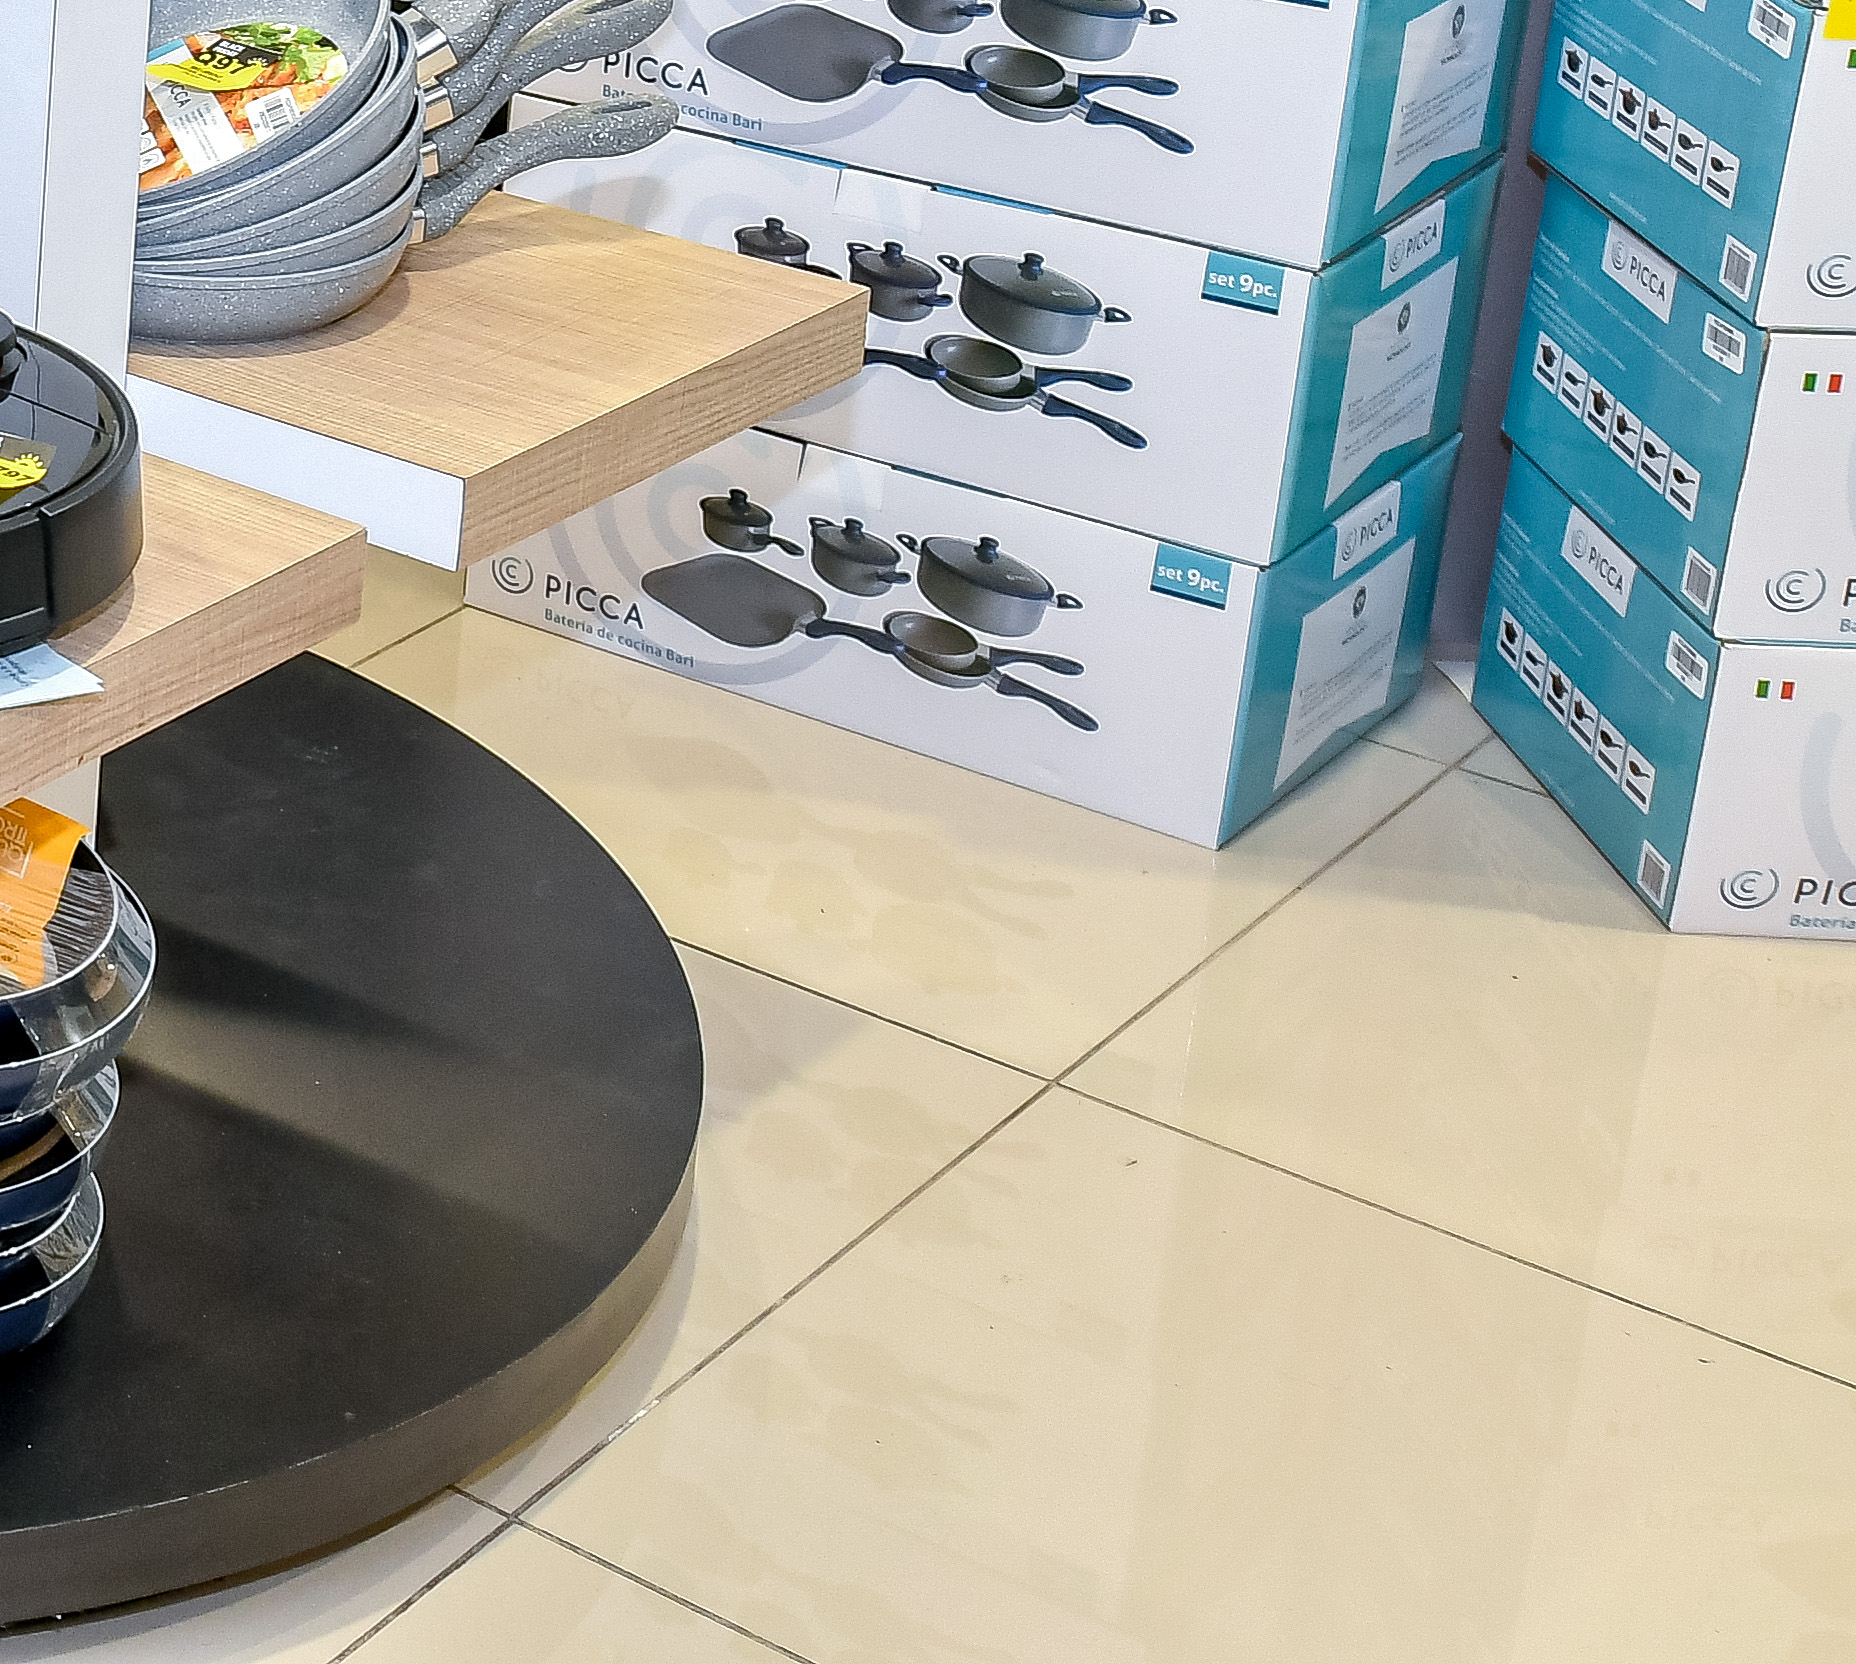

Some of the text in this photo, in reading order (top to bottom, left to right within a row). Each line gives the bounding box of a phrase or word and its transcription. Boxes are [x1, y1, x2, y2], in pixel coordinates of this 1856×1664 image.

[602, 50, 709, 97] PICCA
[680, 104, 763, 132] cocina Bari
[1405, 220, 1439, 260] PICCA
[1208, 270, 1278, 299] set 9pc.
[1628, 253, 1667, 302] PICCA
[1359, 508, 1394, 547] PICCA
[1157, 565, 1226, 595] set 9pc.
[1588, 546, 1624, 596] PICCA
[544, 572, 645, 630] PICCA
[595, 626, 614, 640] de
[616, 633, 662, 658] cocina
[665, 645, 695, 668] Bari
[1793, 877, 1856, 907] PIC
